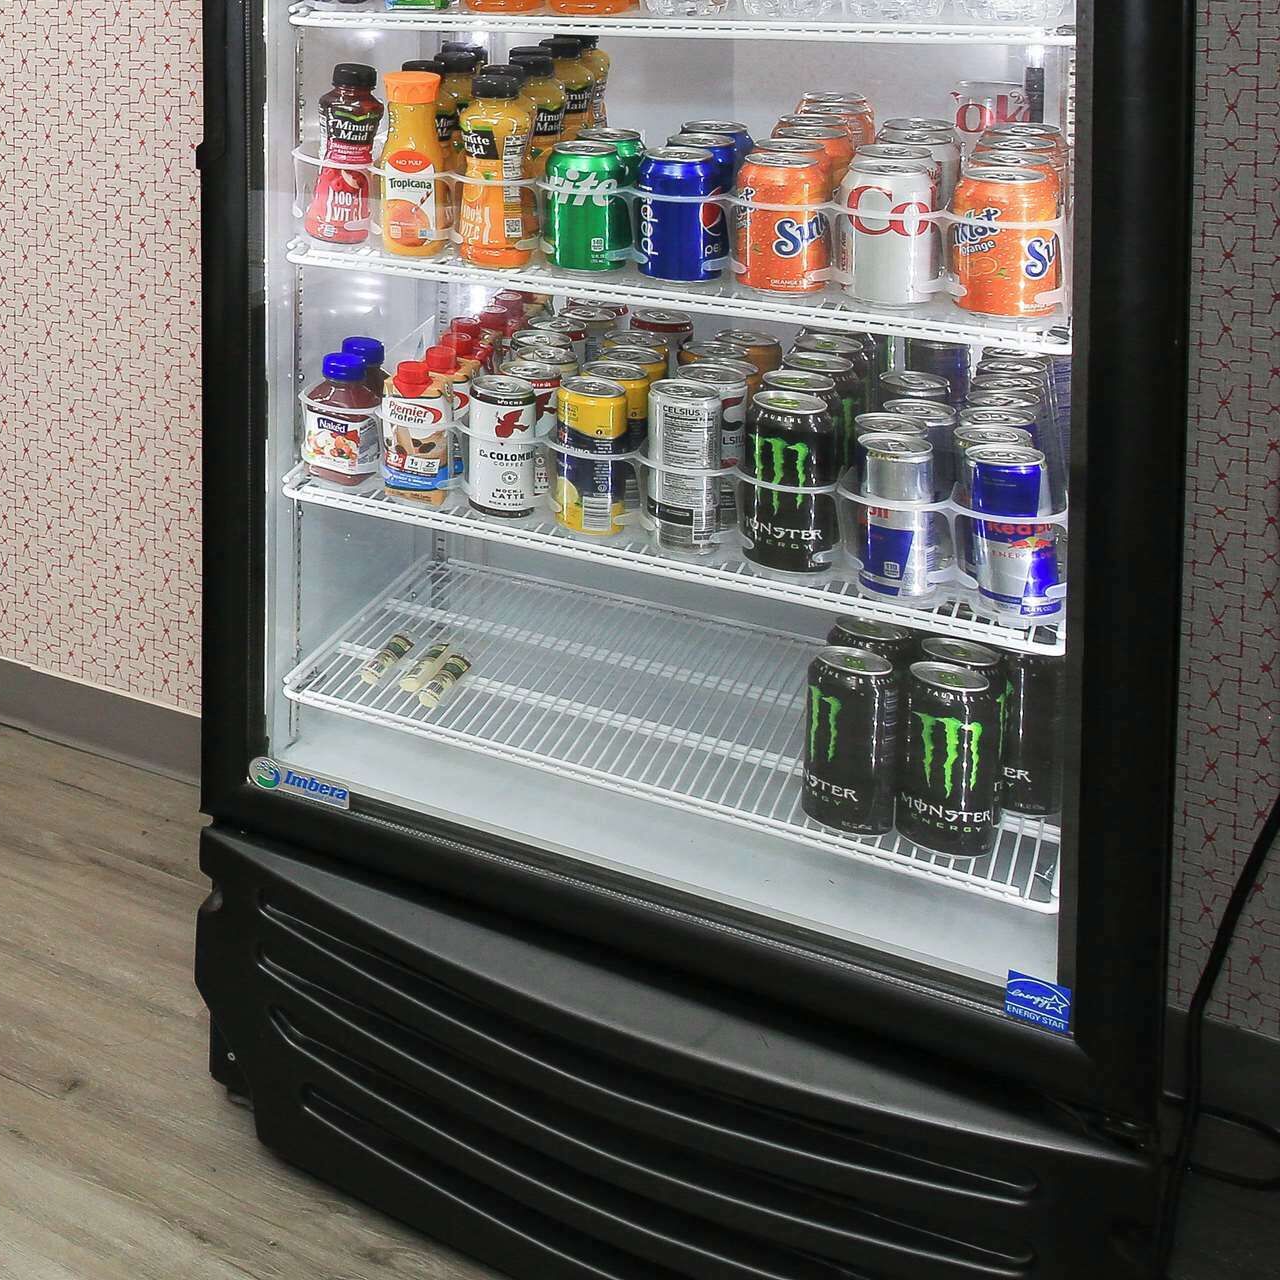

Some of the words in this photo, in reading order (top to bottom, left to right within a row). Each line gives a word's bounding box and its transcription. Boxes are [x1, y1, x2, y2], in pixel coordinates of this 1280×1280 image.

[336, 120, 374, 131] Minute
[340, 130, 368, 141] Maid
[389, 178, 432, 190] Tropicana
[548, 169, 618, 207] rite
[334, 208, 351, 221] VIT
[961, 240, 996, 255] Orange
[389, 400, 428, 418] Premier
[663, 405, 700, 416] CELSIUS
[390, 410, 423, 424] Protein
[319, 420, 346, 434] Naked
[284, 770, 348, 800] Imbera
[901, 791, 990, 822] MONSTER
[911, 813, 982, 833] ENERGY
[1006, 1005, 1040, 1021] ENERGY
[1042, 1016, 1065, 1030] STAR
